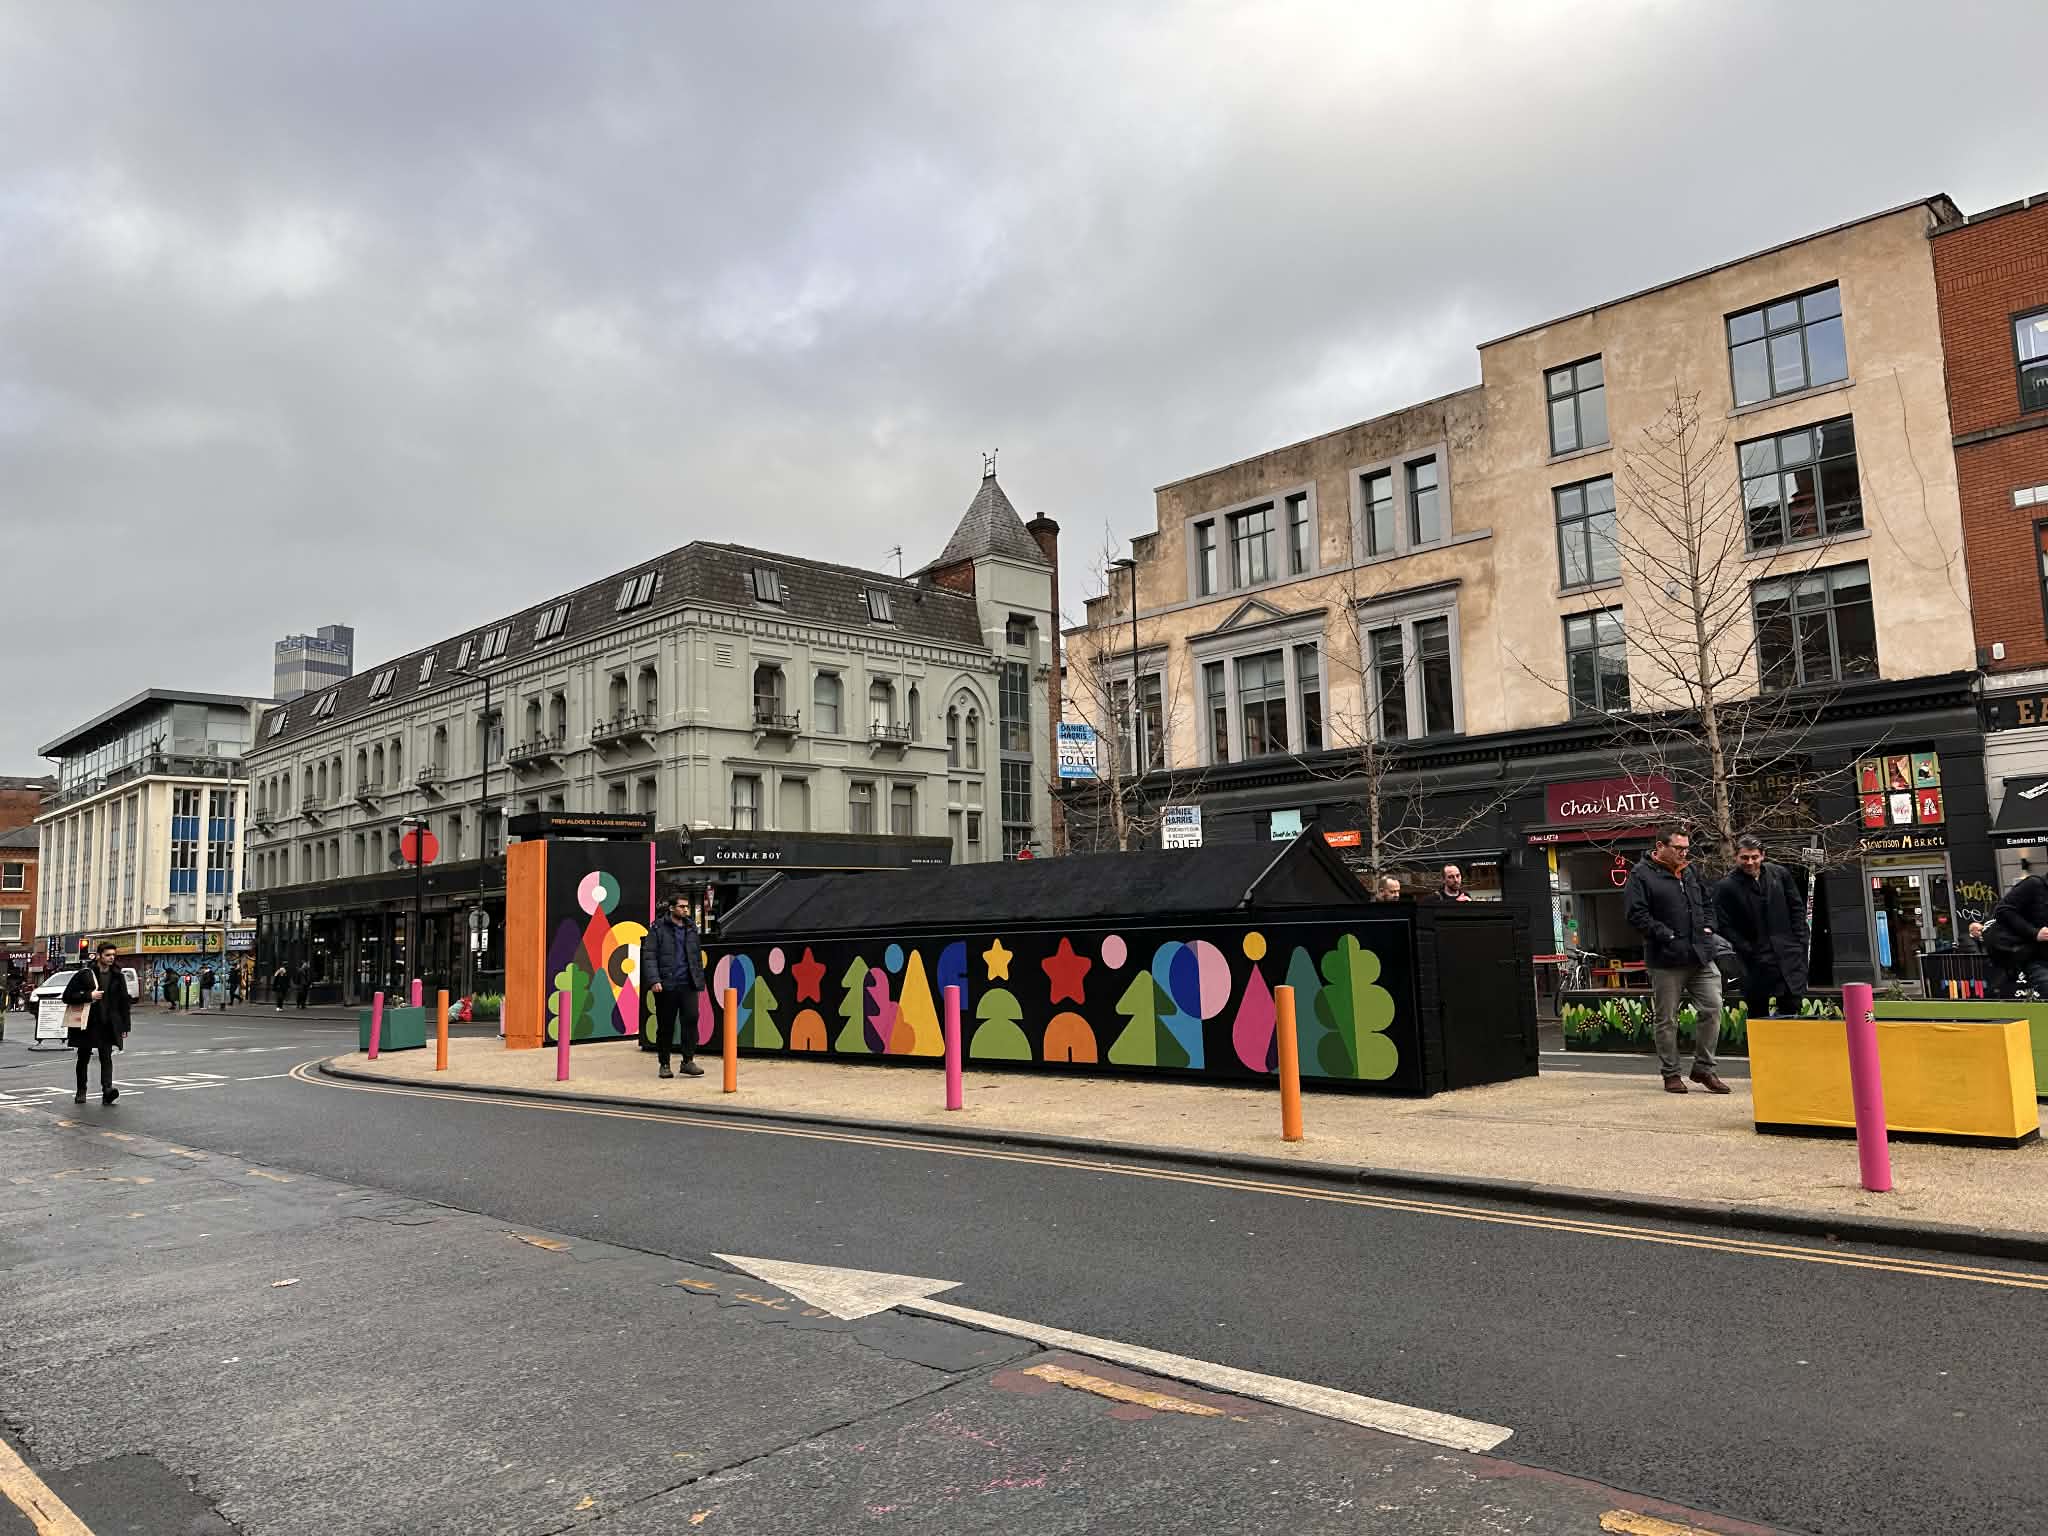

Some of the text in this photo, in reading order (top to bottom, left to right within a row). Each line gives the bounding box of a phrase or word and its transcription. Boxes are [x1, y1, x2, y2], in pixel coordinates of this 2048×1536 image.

[1060, 724, 1086, 732] DANIEL
[1059, 732, 1088, 740] HARRIS
[1060, 756, 1096, 765] TO LET
[1560, 799, 1601, 817] Chai
[1166, 839, 1201, 849] TO LET
[2006, 837, 2036, 845] Eastern
[716, 851, 782, 860] CORNER BOY
[143, 934, 182, 946] FRESH
